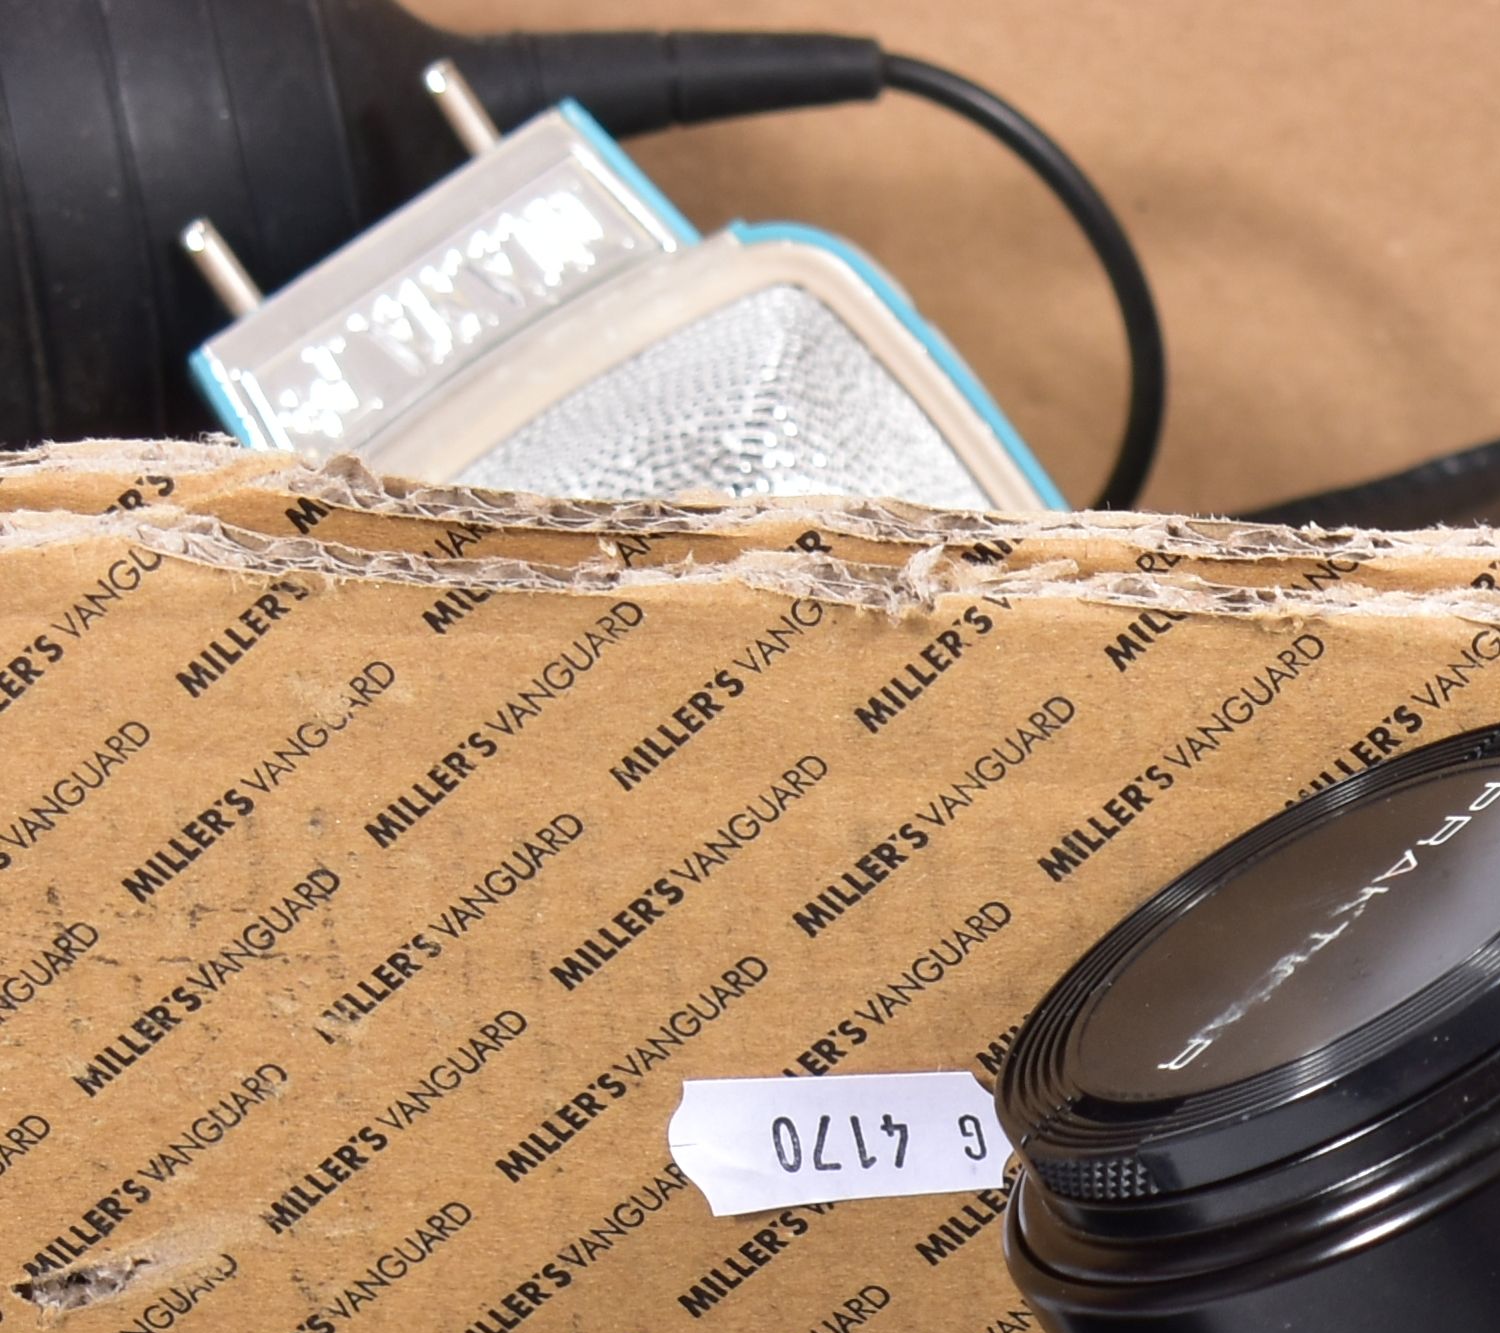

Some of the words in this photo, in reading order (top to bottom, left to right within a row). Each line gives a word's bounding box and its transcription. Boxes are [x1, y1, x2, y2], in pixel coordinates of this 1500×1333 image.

[363, 732, 498, 849] MILLER'S
[484, 601, 644, 735] VANGUARD
[1037, 764, 1174, 883] MILLER'S
[1163, 633, 1325, 769] VANGUARD
[72, 986, 202, 1098] MILLER'S
[185, 868, 340, 992] VANGUARD
[549, 878, 684, 992] MILLER'S
[669, 755, 828, 883] VANGUARD
[261, 1126, 388, 1235] MILLER'S
[375, 1010, 528, 1130] VANGUARD
[495, 1073, 627, 1183] MILLER'S
[611, 956, 769, 1077] VANGUARD
[771, 1113, 910, 1174] 4170
[958, 1113, 988, 1162] G
